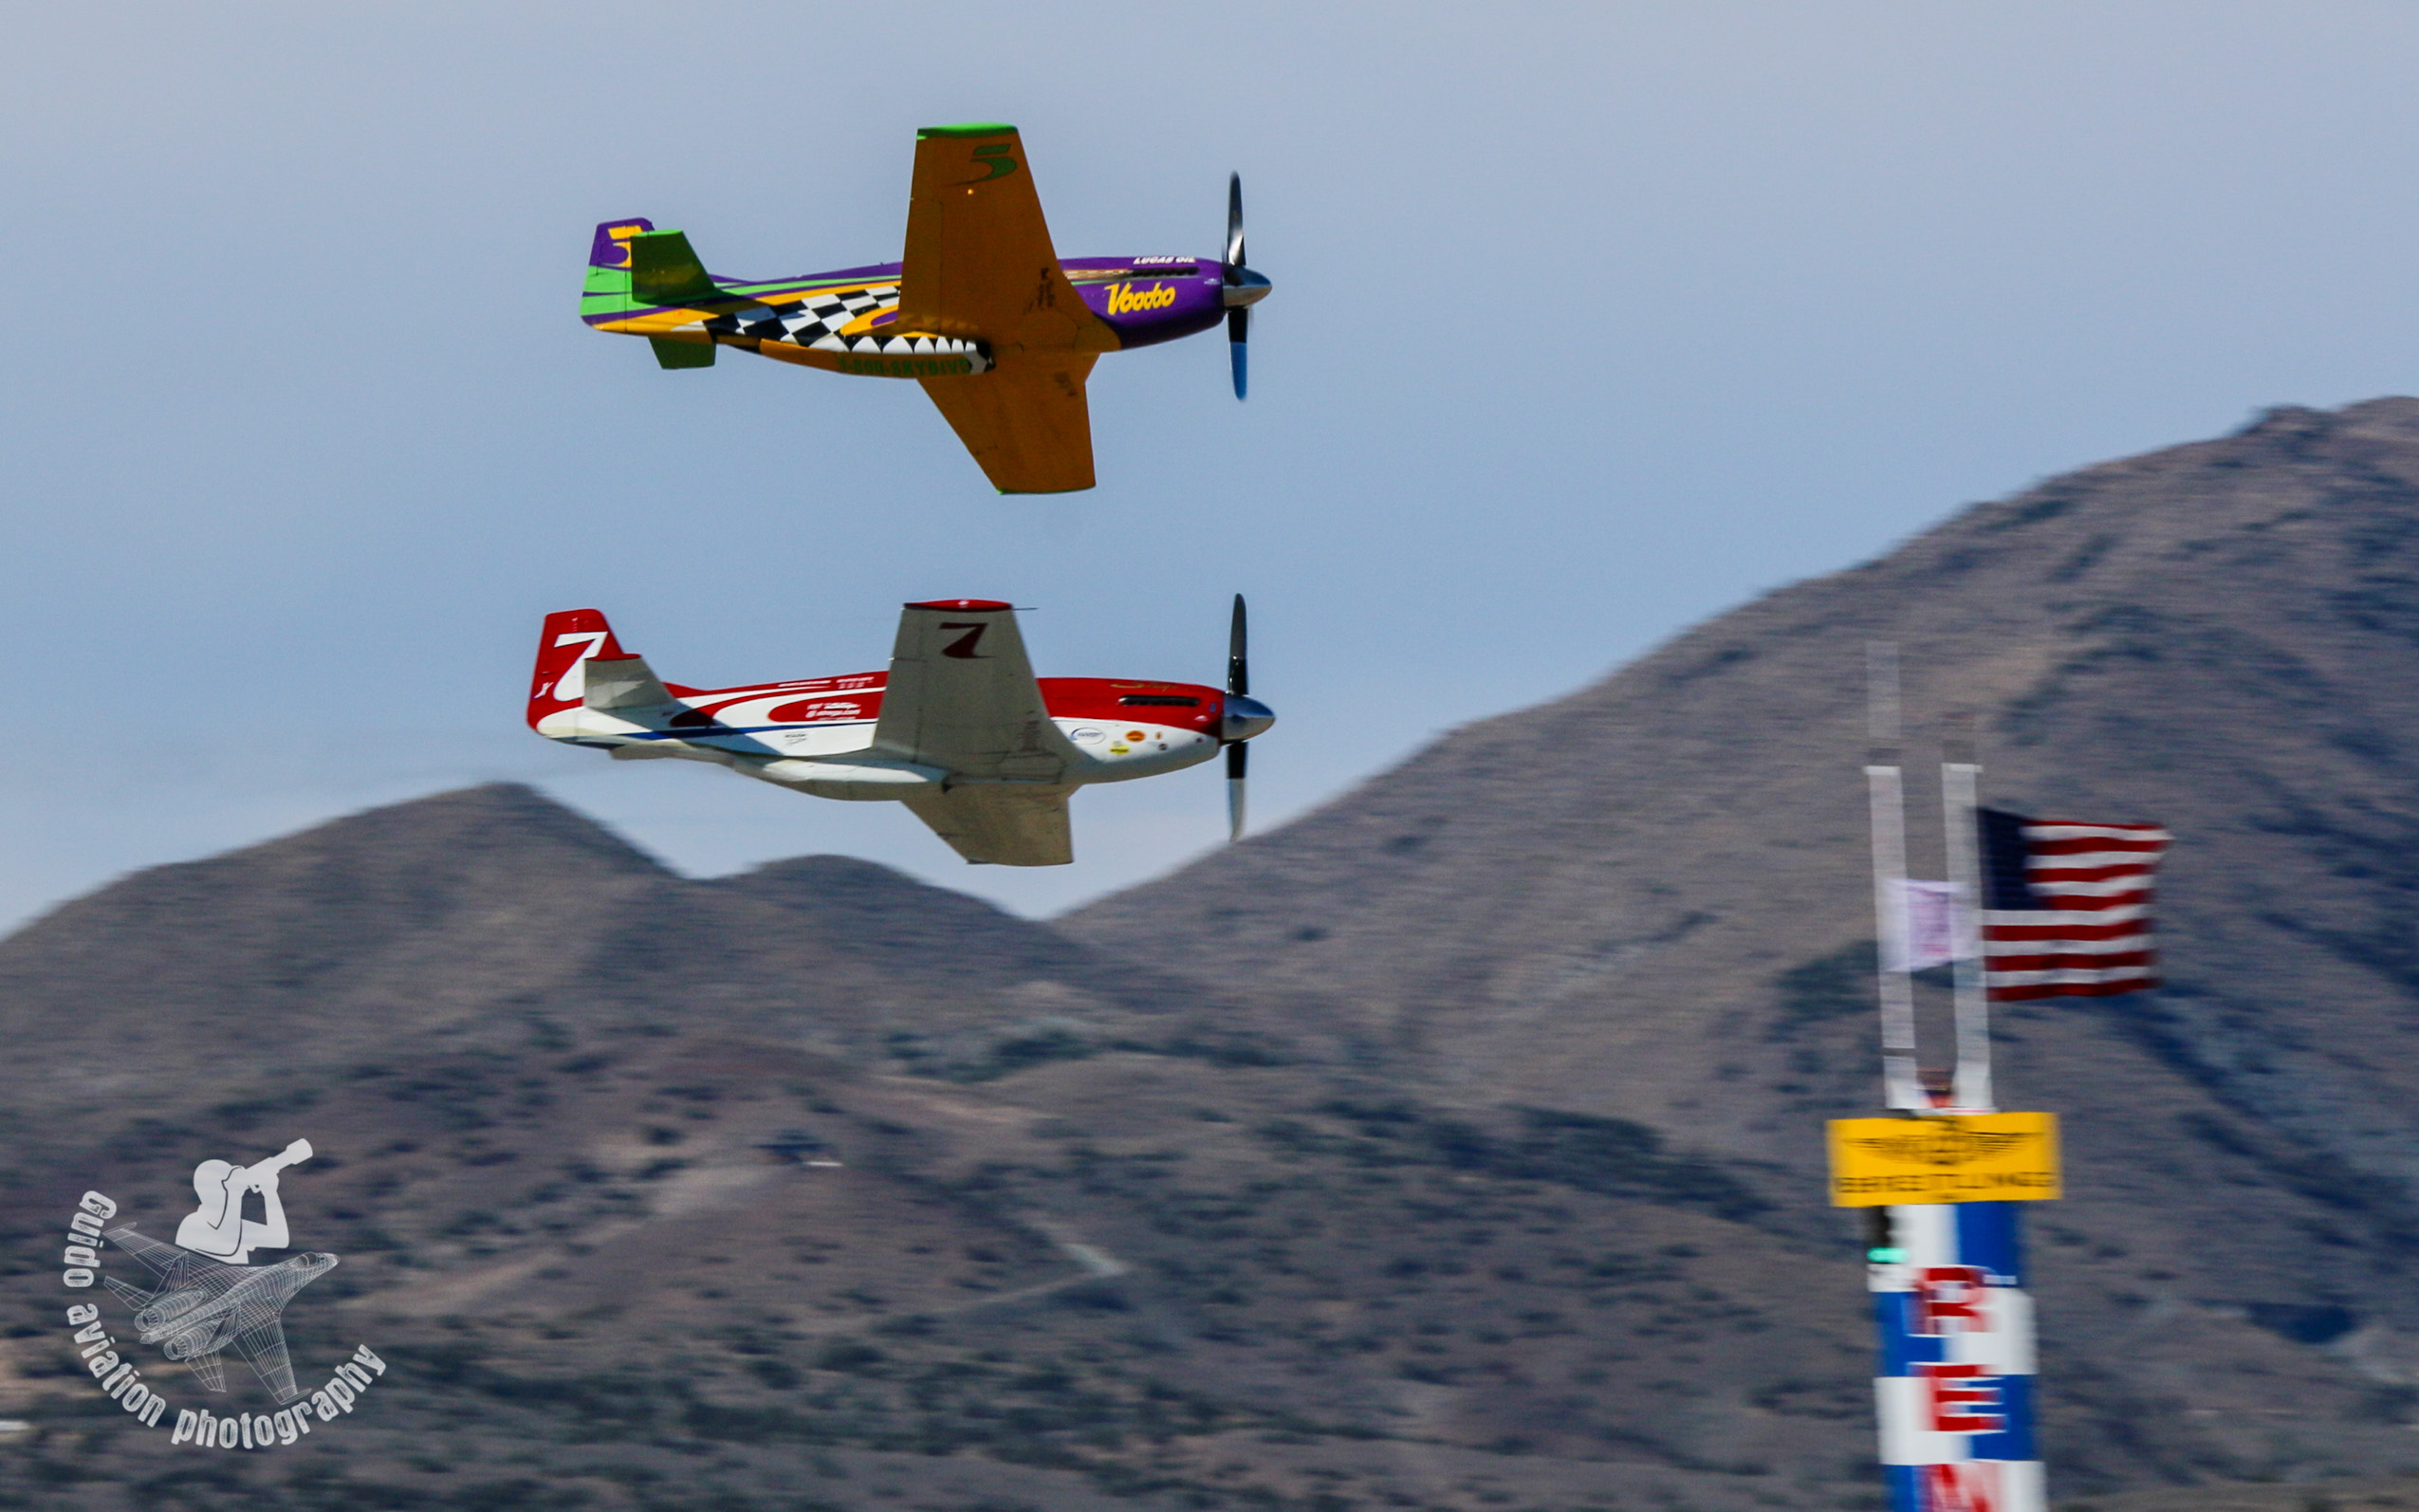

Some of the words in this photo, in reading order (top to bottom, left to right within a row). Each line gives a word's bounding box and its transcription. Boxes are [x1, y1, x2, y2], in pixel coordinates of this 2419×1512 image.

[947, 143, 1018, 187] 5
[1133, 256, 1174, 265] LUCAS
[1103, 281, 1176, 316] Voodoo
[938, 621, 995, 659] 7
[553, 631, 609, 702] 7
